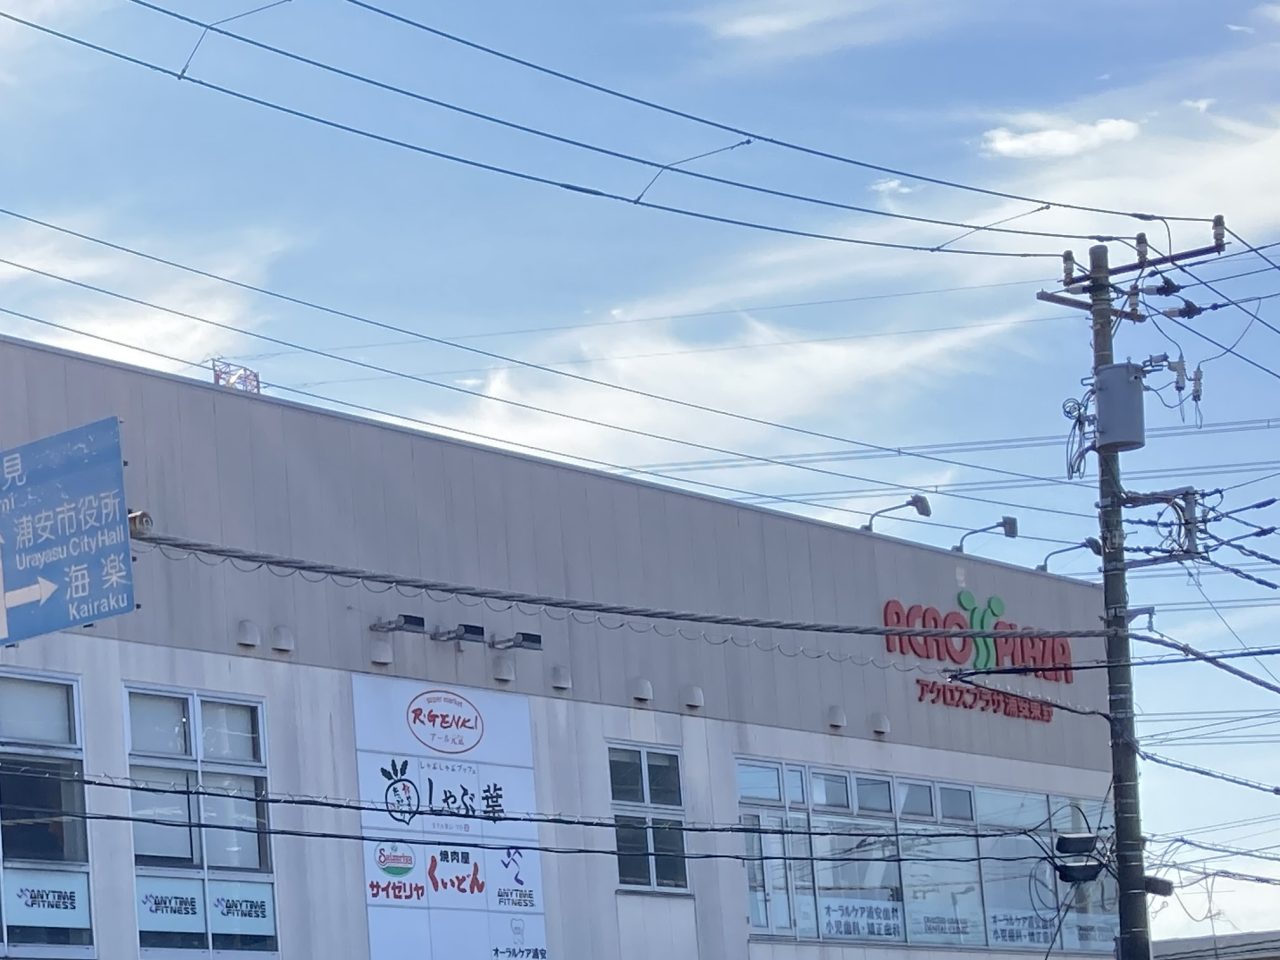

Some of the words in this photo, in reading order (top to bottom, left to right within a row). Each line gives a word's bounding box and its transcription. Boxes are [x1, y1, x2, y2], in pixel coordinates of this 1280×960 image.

[14, 489, 121, 550] 浦安市役所
[15, 545, 67, 571] Urayasu
[69, 535, 96, 556] City
[98, 525, 124, 548] Hall
[68, 593, 128, 620] Kairaku
[426, 777, 505, 825] しゃぶ葉
[439, 850, 470, 864] 焼肉屋
[428, 855, 485, 894] くいどん
[29, 889, 76, 901] ANYTIME
[369, 880, 425, 901] サイゼリヤ
[498, 888, 534, 899] ANYTIME
[30, 899, 77, 910] FITNESS
[154, 895, 197, 907] ANYTIME
[225, 899, 266, 911] ANYTIME
[498, 898, 535, 907] FITNESS
[154, 906, 198, 915] FITNESS
[226, 909, 268, 919] FITNESS
